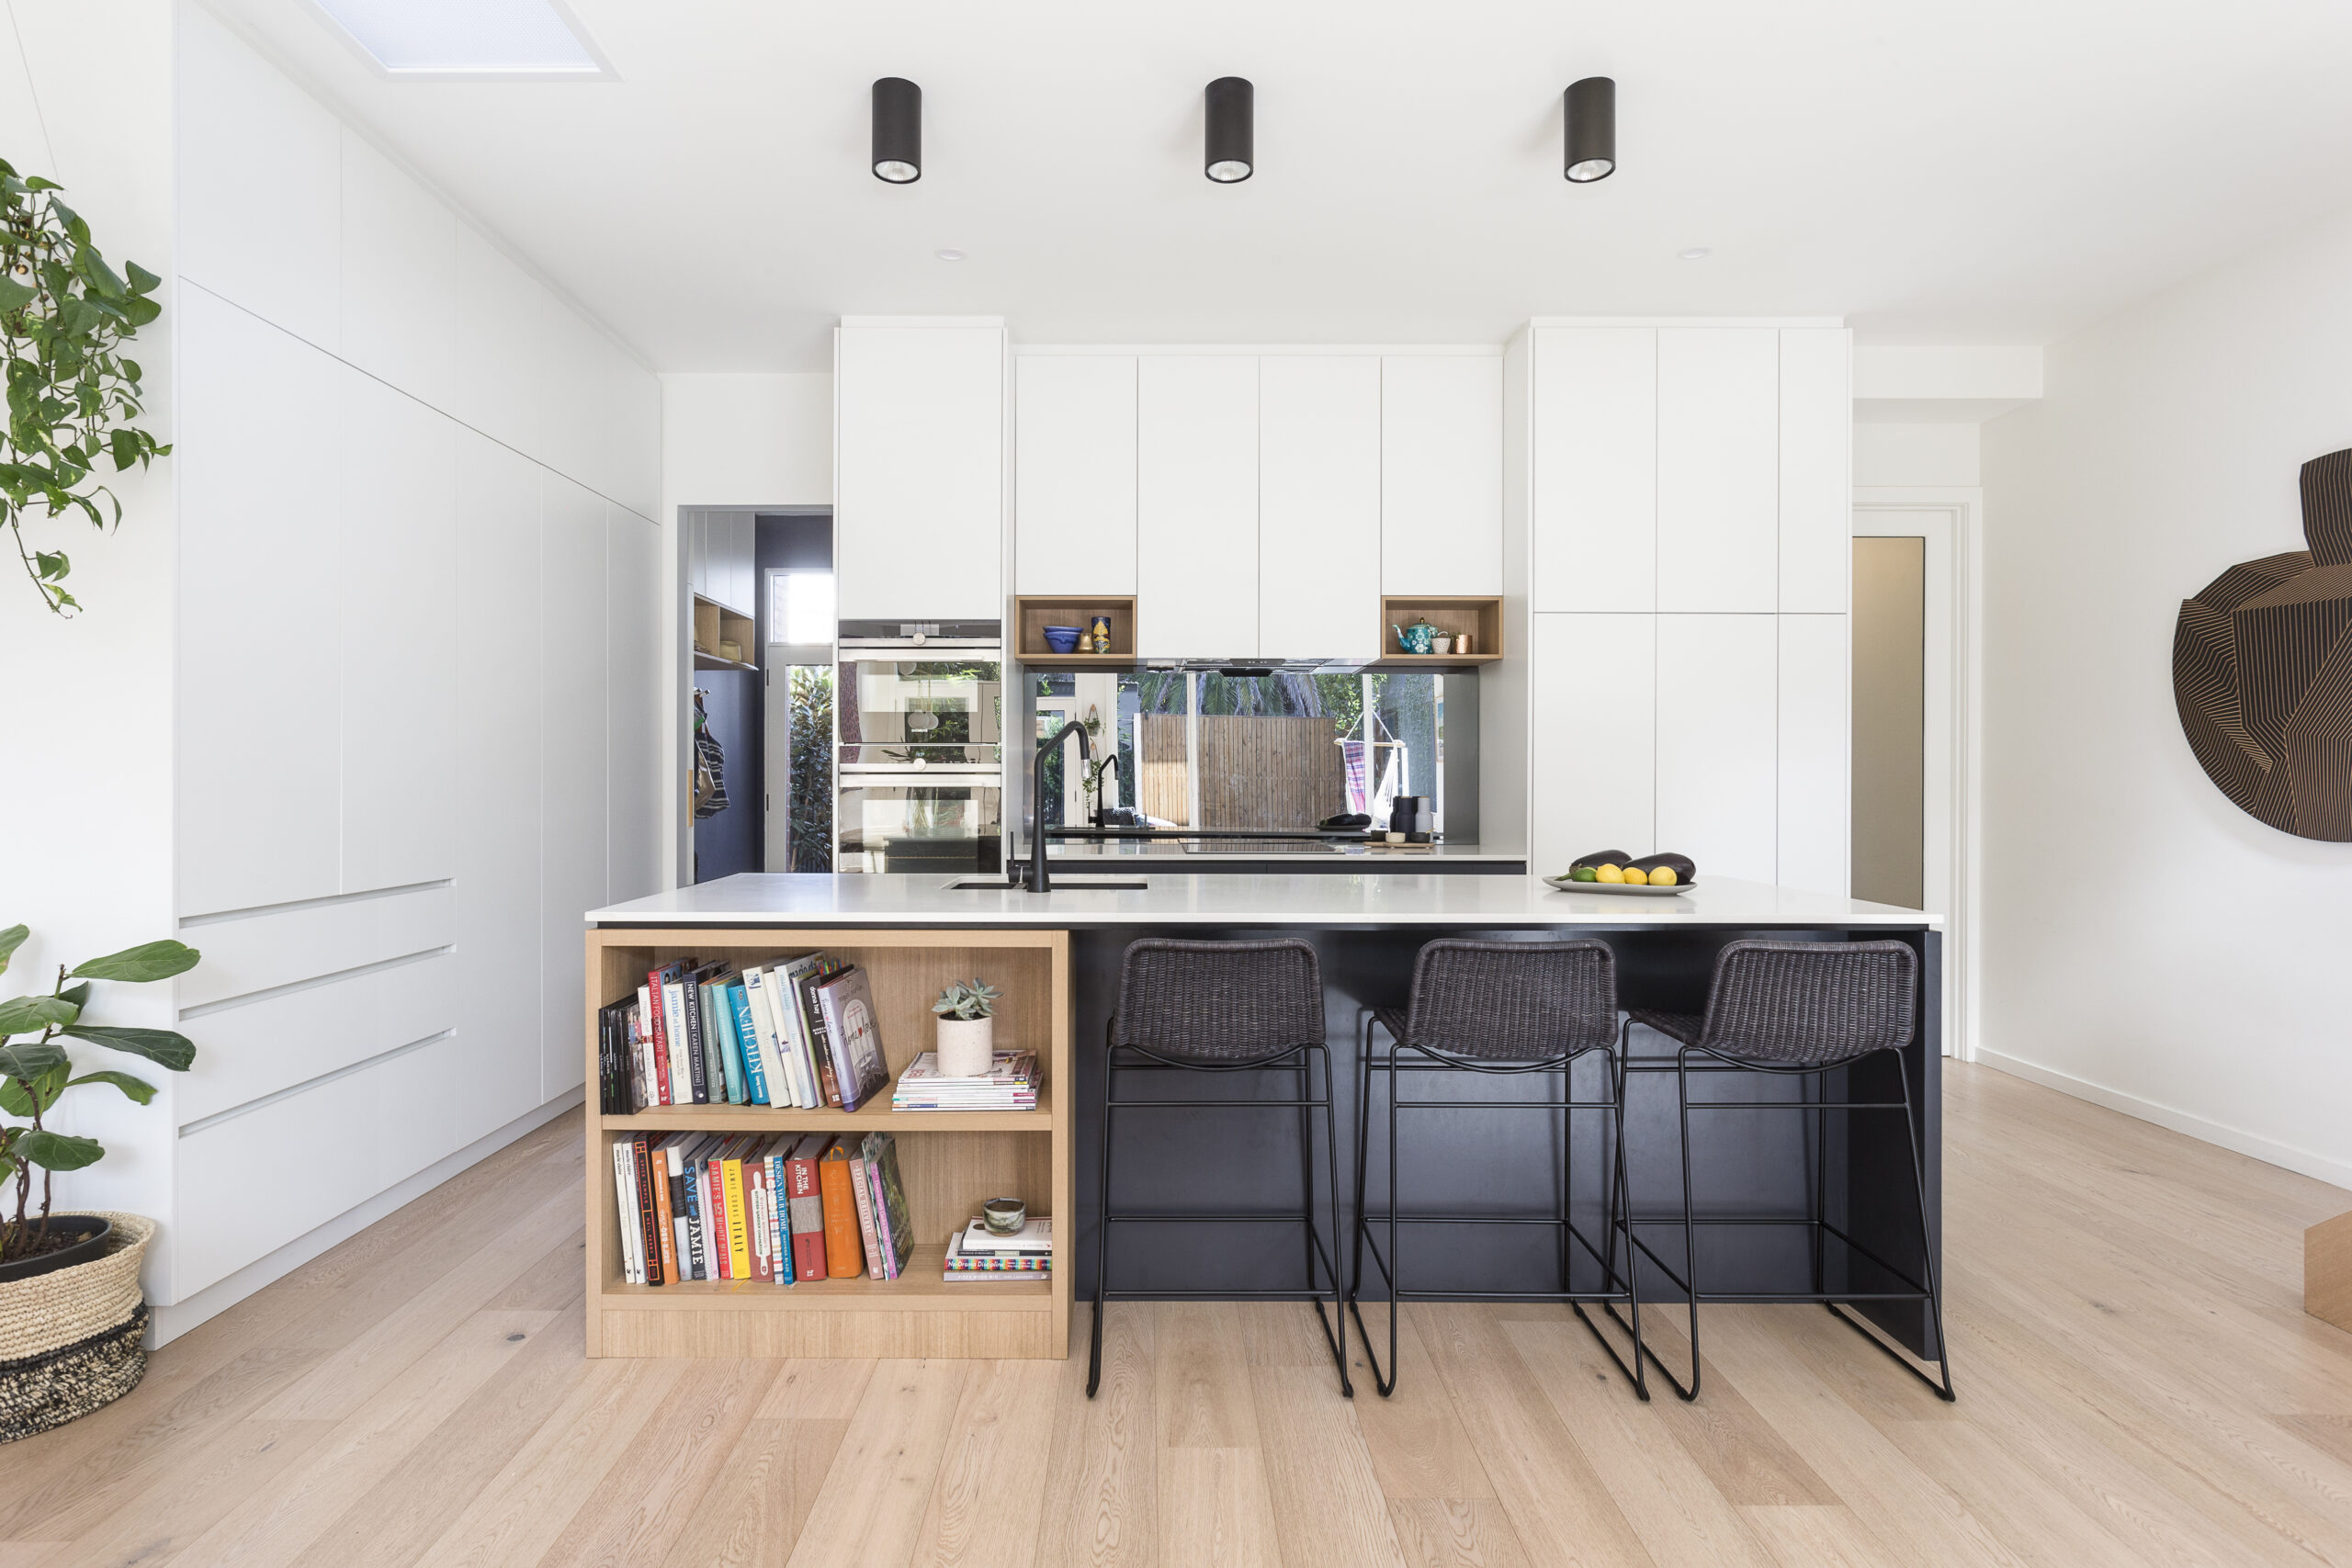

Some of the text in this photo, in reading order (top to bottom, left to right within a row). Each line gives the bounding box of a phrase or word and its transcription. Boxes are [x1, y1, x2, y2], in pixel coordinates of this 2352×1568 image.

[650, 976, 659, 1004] ITALIAN
[669, 988, 681, 1016] jamie
[778, 974, 792, 1010] marie claire
[808, 986, 820, 1014] donna hay
[652, 1006, 661, 1025] FOOD
[654, 1026, 662, 1052] SAFARI
[673, 1024, 684, 1046] home
[688, 1001, 696, 1029] KITCHEN
[693, 1056, 701, 1083] MARTINI
[737, 1004, 763, 1074] KITCHEN
[684, 1166, 697, 1201] SAVE
[710, 1164, 721, 1200] JAMIE'S
[795, 1164, 803, 1194] KITCHEN
[801, 1167, 807, 1175] IN
[713, 1202, 722, 1215] 15
[730, 1195, 739, 1217] COOKS
[774, 1160, 786, 1231] DESIGN YOUR HOME
[854, 1168, 865, 1197] SPECIAL
[860, 1200, 872, 1234] DELIVERY
[688, 1217, 703, 1264] JAMIE
[715, 1216, 725, 1241] MINUTE
[732, 1221, 743, 1252] ITALY
[718, 1243, 727, 1264] MEALS
